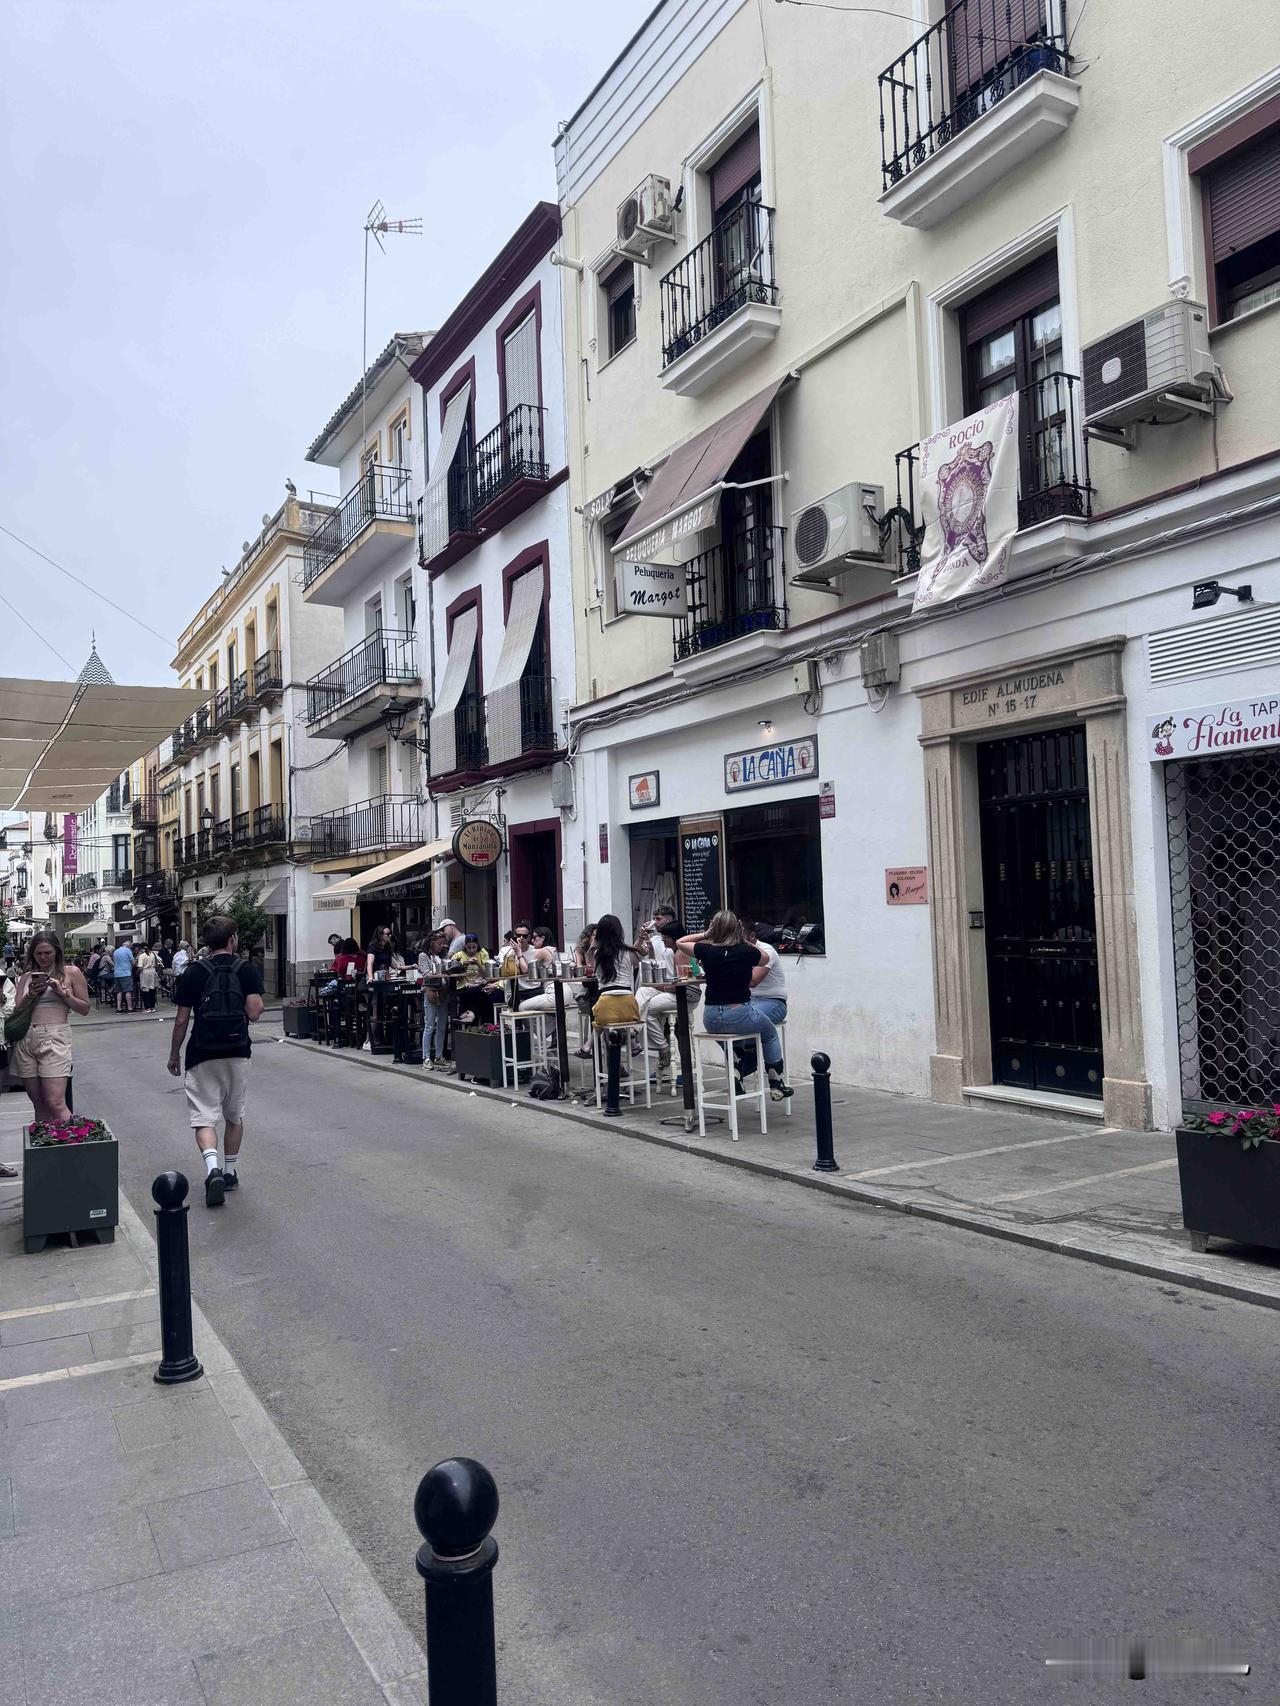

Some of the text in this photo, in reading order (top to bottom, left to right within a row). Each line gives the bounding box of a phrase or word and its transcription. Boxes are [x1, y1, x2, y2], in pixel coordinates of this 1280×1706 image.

[671, 507, 704, 541] MARGOT
[630, 586, 681, 607] Margot
[963, 671, 1065, 706] EDIF ALMUDENA
[1216, 707, 1243, 727] La
[742, 746, 796, 782] LA CAÑA
[463, 842, 497, 850] Manzanilla
